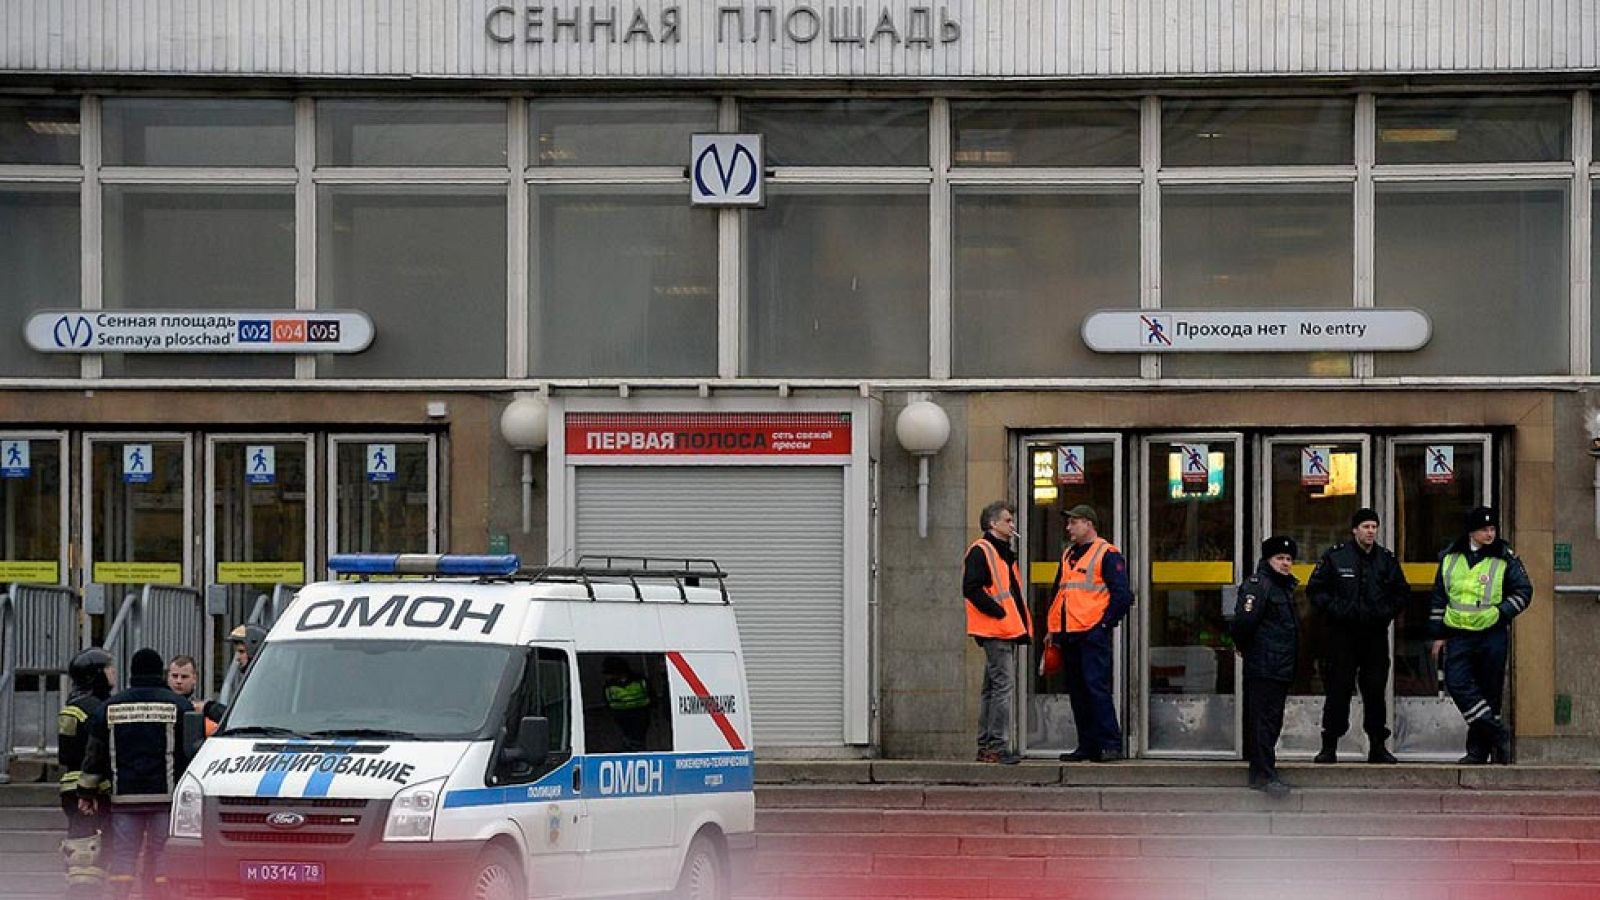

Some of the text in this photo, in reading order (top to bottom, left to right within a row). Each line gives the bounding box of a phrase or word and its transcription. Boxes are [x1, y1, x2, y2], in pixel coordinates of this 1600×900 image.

[484, 5, 962, 50] СЕННАЯ ПЛОЩАДЬ
[96, 313, 236, 330] Сенная площадь
[1176, 321, 1288, 339] Прохода нет
[1300, 322, 1367, 339] No entry
[97, 332, 162, 348] Sennaya
[771, 431, 795, 441] сеть
[294, 594, 506, 635] ОМОН
[201, 753, 416, 785] РАЗМИНИРОВАНИЕ
[599, 759, 663, 795] ОМОН
[260, 865, 298, 881] 0314
[303, 865, 320, 877] 78
